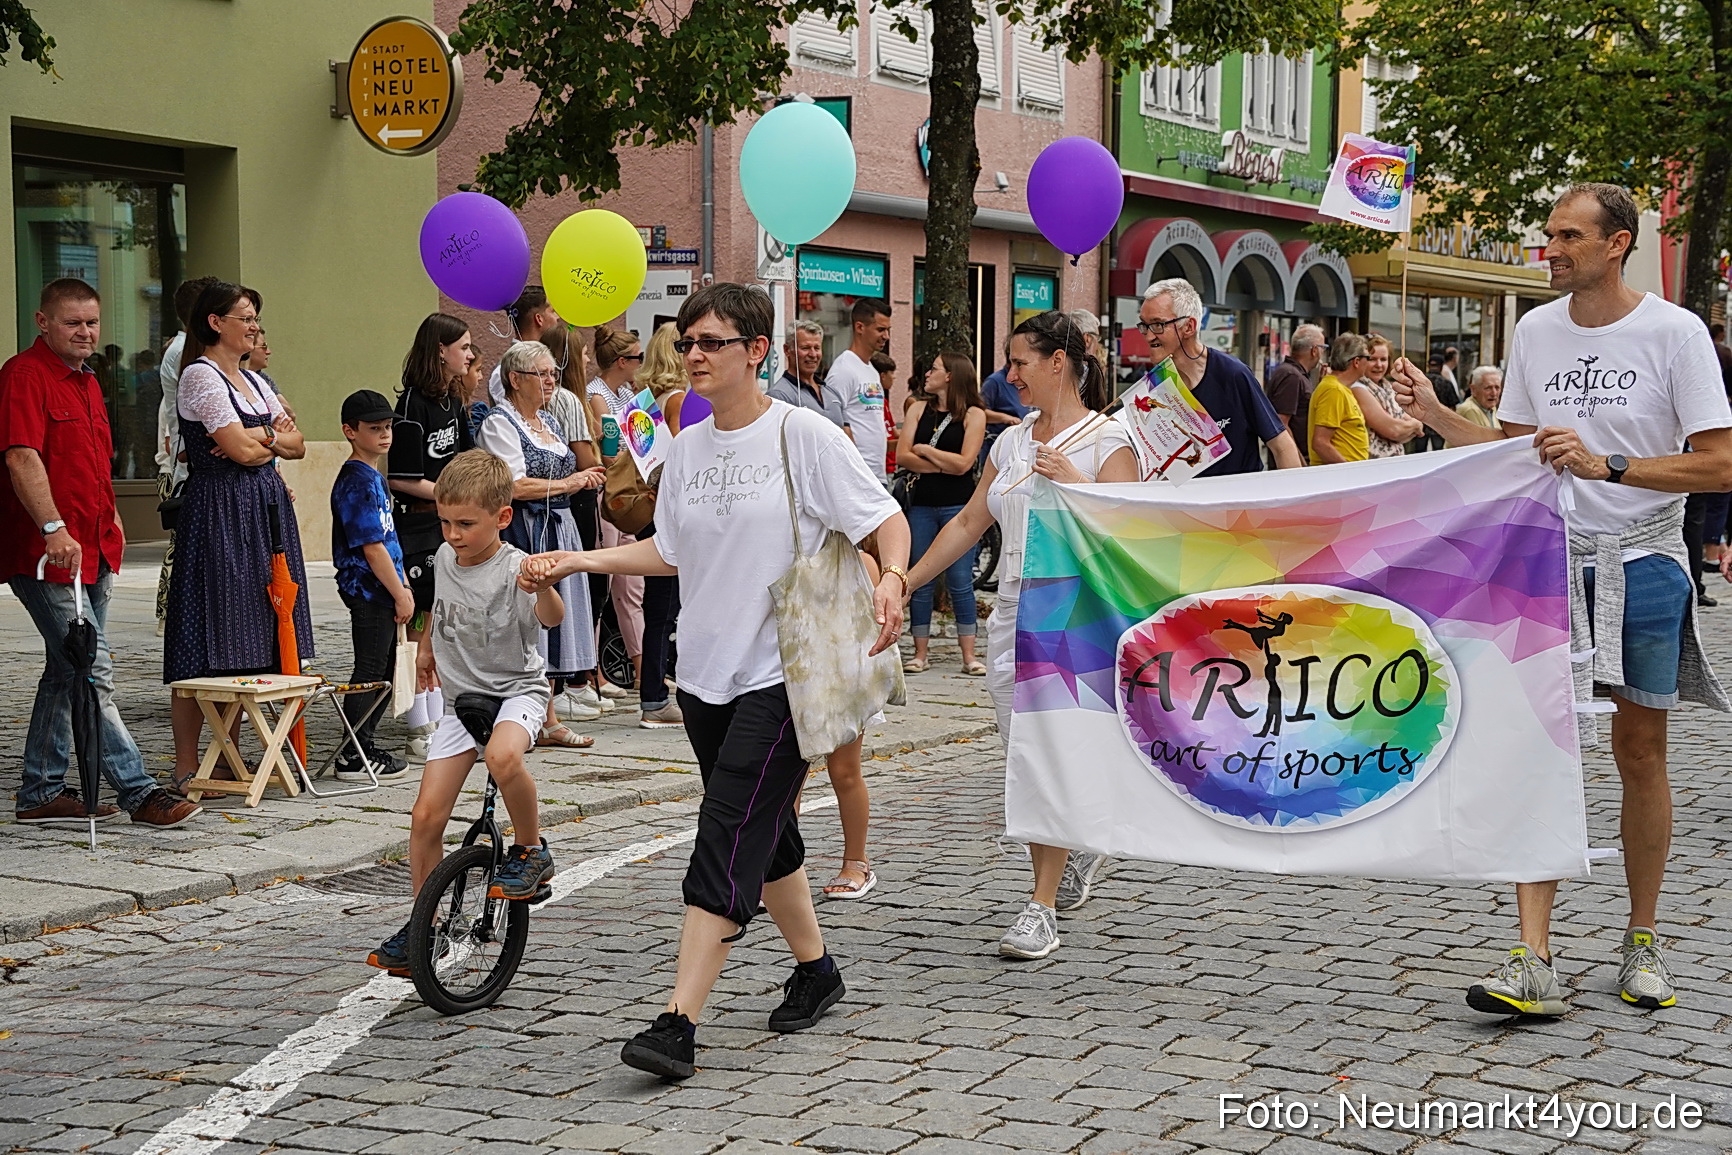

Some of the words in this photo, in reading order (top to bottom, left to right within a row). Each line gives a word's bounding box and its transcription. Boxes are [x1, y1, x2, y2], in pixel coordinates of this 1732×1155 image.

[372, 44, 405, 54] STADT
[373, 58, 440, 76] HOTEL
[373, 79, 413, 96] NEU
[374, 98, 440, 117] MARKT
[1348, 184, 1369, 196] art
[1369, 190, 1382, 200] of
[1350, 209, 1391, 225] www.artico.de
[439, 229, 480, 264] ARTICO
[647, 249, 696, 265] kwirtsgasse
[570, 267, 617, 294] ARTICO
[570, 278, 584, 288] art
[799, 261, 845, 285] Spirituosen
[850, 267, 884, 292] Whisky
[637, 289, 662, 300] enezia
[1016, 283, 1035, 304] Essig
[1544, 362, 1637, 394] ARTICO
[1549, 395, 1573, 407] art
[1573, 393, 1588, 408] of
[1588, 395, 1628, 411] sports
[1135, 425, 1163, 462] www.artico.de
[685, 458, 771, 492] ARTICO
[688, 493, 709, 506] art
[711, 490, 725, 506] of
[726, 490, 761, 507] sports
[1122, 632, 1430, 738] ARTICO
[1150, 739, 1218, 772] art
[1222, 740, 1278, 783] of
[1278, 740, 1424, 790] sports
